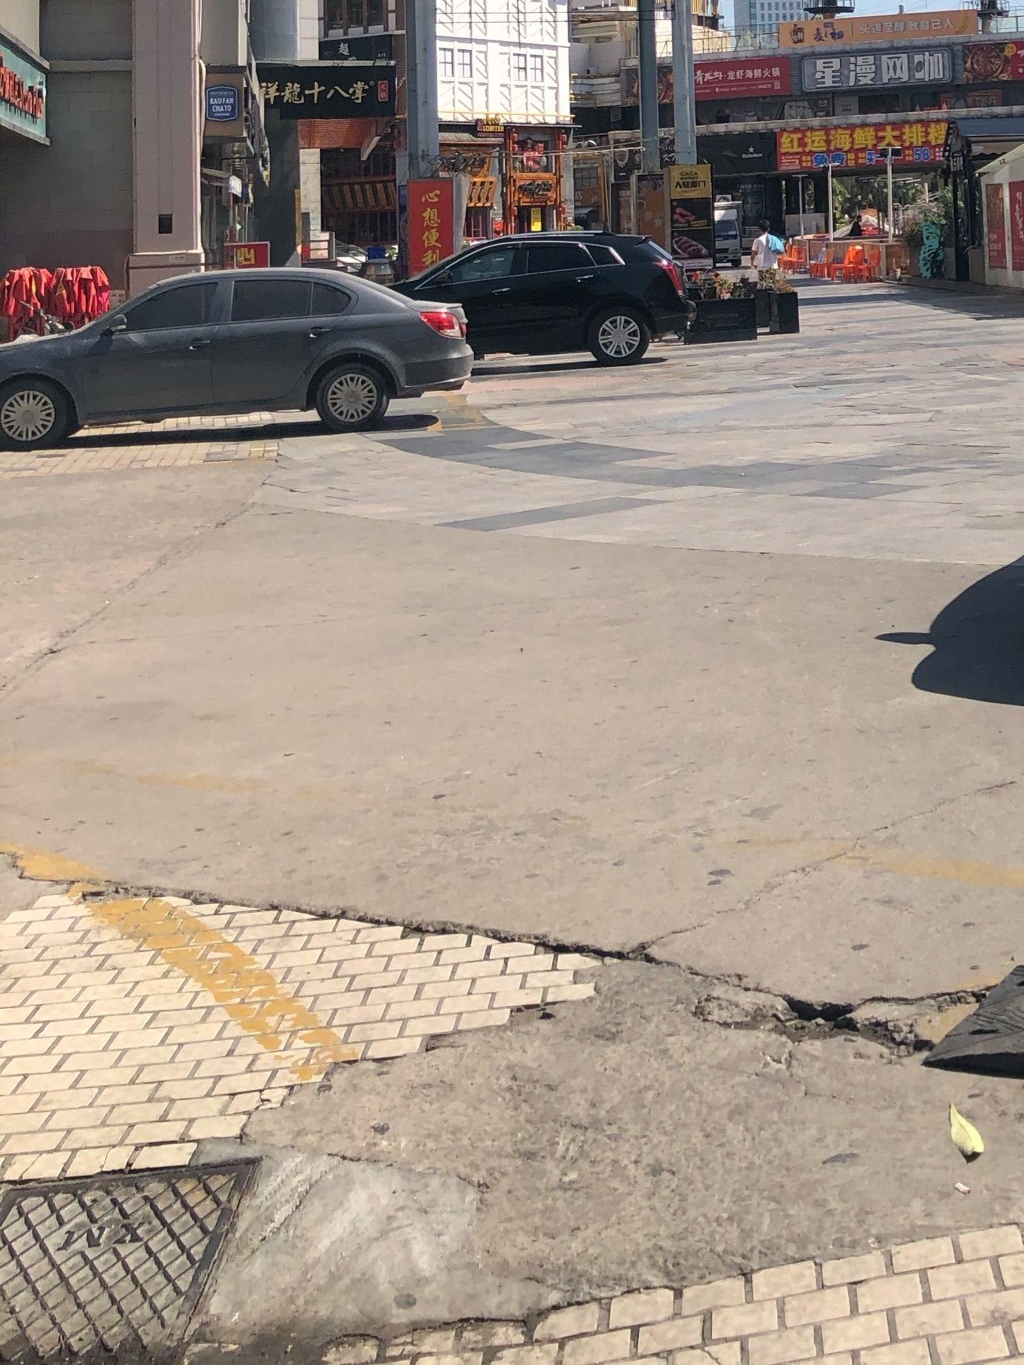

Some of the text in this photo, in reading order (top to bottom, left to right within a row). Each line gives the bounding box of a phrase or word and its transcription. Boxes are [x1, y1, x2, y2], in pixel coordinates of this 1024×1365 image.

[815, 52, 943, 87] 星漫网咖
[780, 122, 948, 154] 红运海鲜大排档
[913, 147, 931, 162] 58
[421, 189, 442, 268] 心想便利
